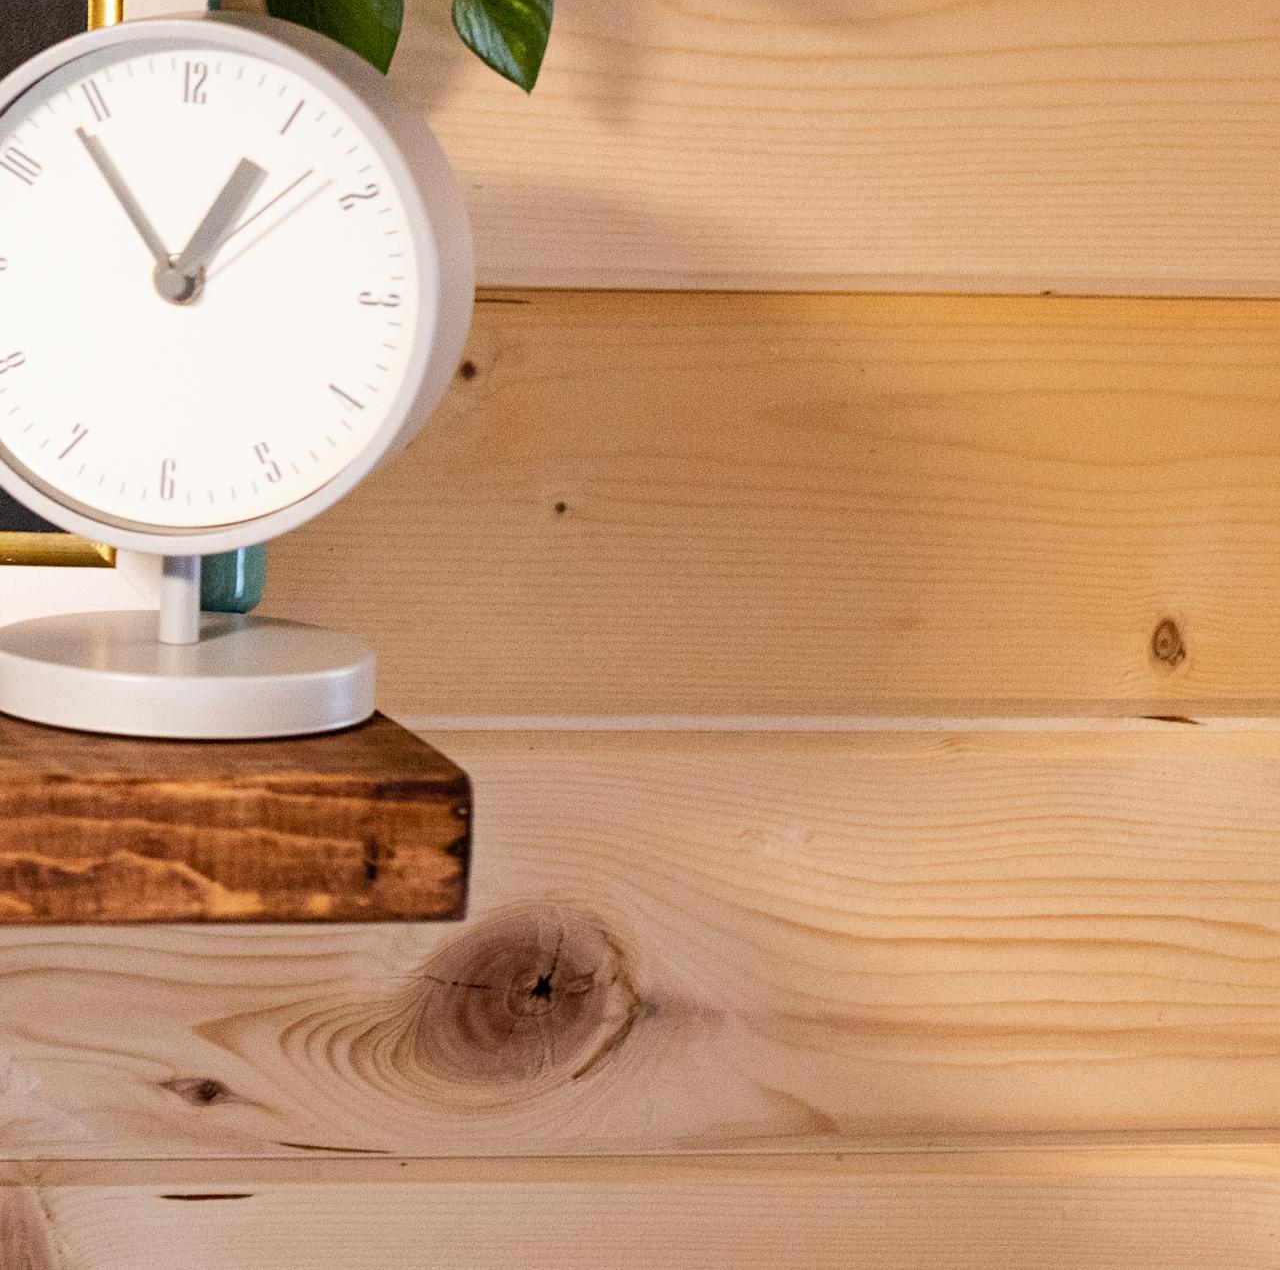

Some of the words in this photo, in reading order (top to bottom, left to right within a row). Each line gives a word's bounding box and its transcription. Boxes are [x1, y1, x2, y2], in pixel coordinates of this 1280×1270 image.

[81, 79, 111, 122] 11
[183, 61, 208, 105] 12
[280, 100, 306, 135] 1
[338, 184, 380, 211] 2
[358, 291, 401, 309] 3
[58, 422, 89, 460] 7
[159, 458, 176, 502] 6
[252, 441, 283, 484] 5
